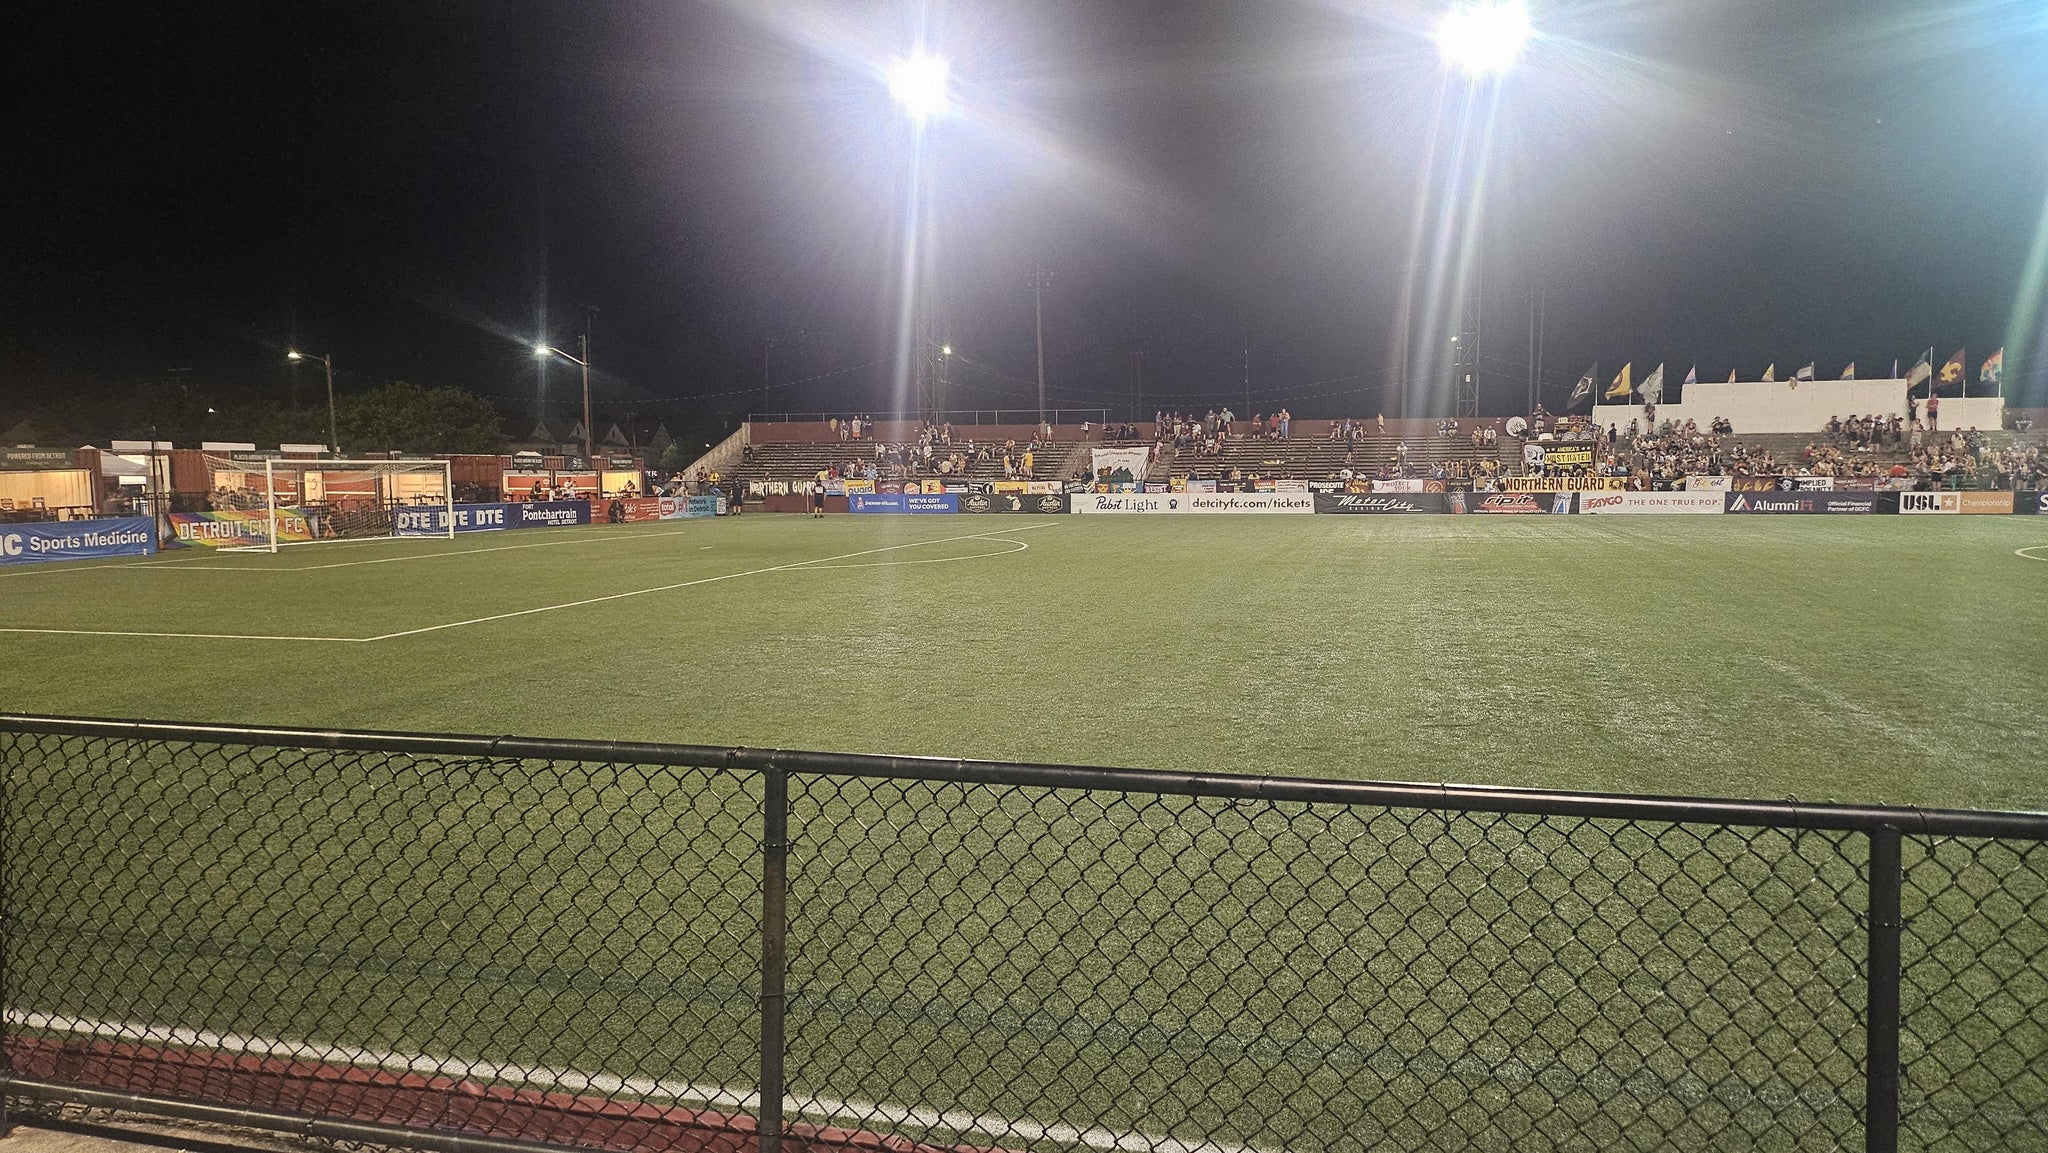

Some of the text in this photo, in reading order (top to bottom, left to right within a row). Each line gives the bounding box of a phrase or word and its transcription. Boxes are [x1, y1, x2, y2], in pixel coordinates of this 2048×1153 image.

[750, 481, 789, 497] NORTHERN
[1505, 478, 1605, 491] NORTHERN GUARD
[967, 499, 988, 507] Austin
[1040, 499, 1061, 507] Austin
[1096, 496, 1158, 512] Pabst Light
[1192, 498, 1311, 511] detcityfc.com/tickets
[1484, 495, 1534, 507] rip it
[1587, 496, 1623, 508] FAYGO
[1753, 500, 1813, 511] AlumniFi
[1903, 495, 1941, 511] USL
[398, 512, 431, 529] DTE
[476, 510, 504, 526] DTE
[522, 508, 577, 521] Pontchartrain
[178, 520, 243, 541] DETROIT
[285, 517, 304, 534] FC
[30, 535, 81, 553] Sports
[84, 530, 148, 547] Medicine
